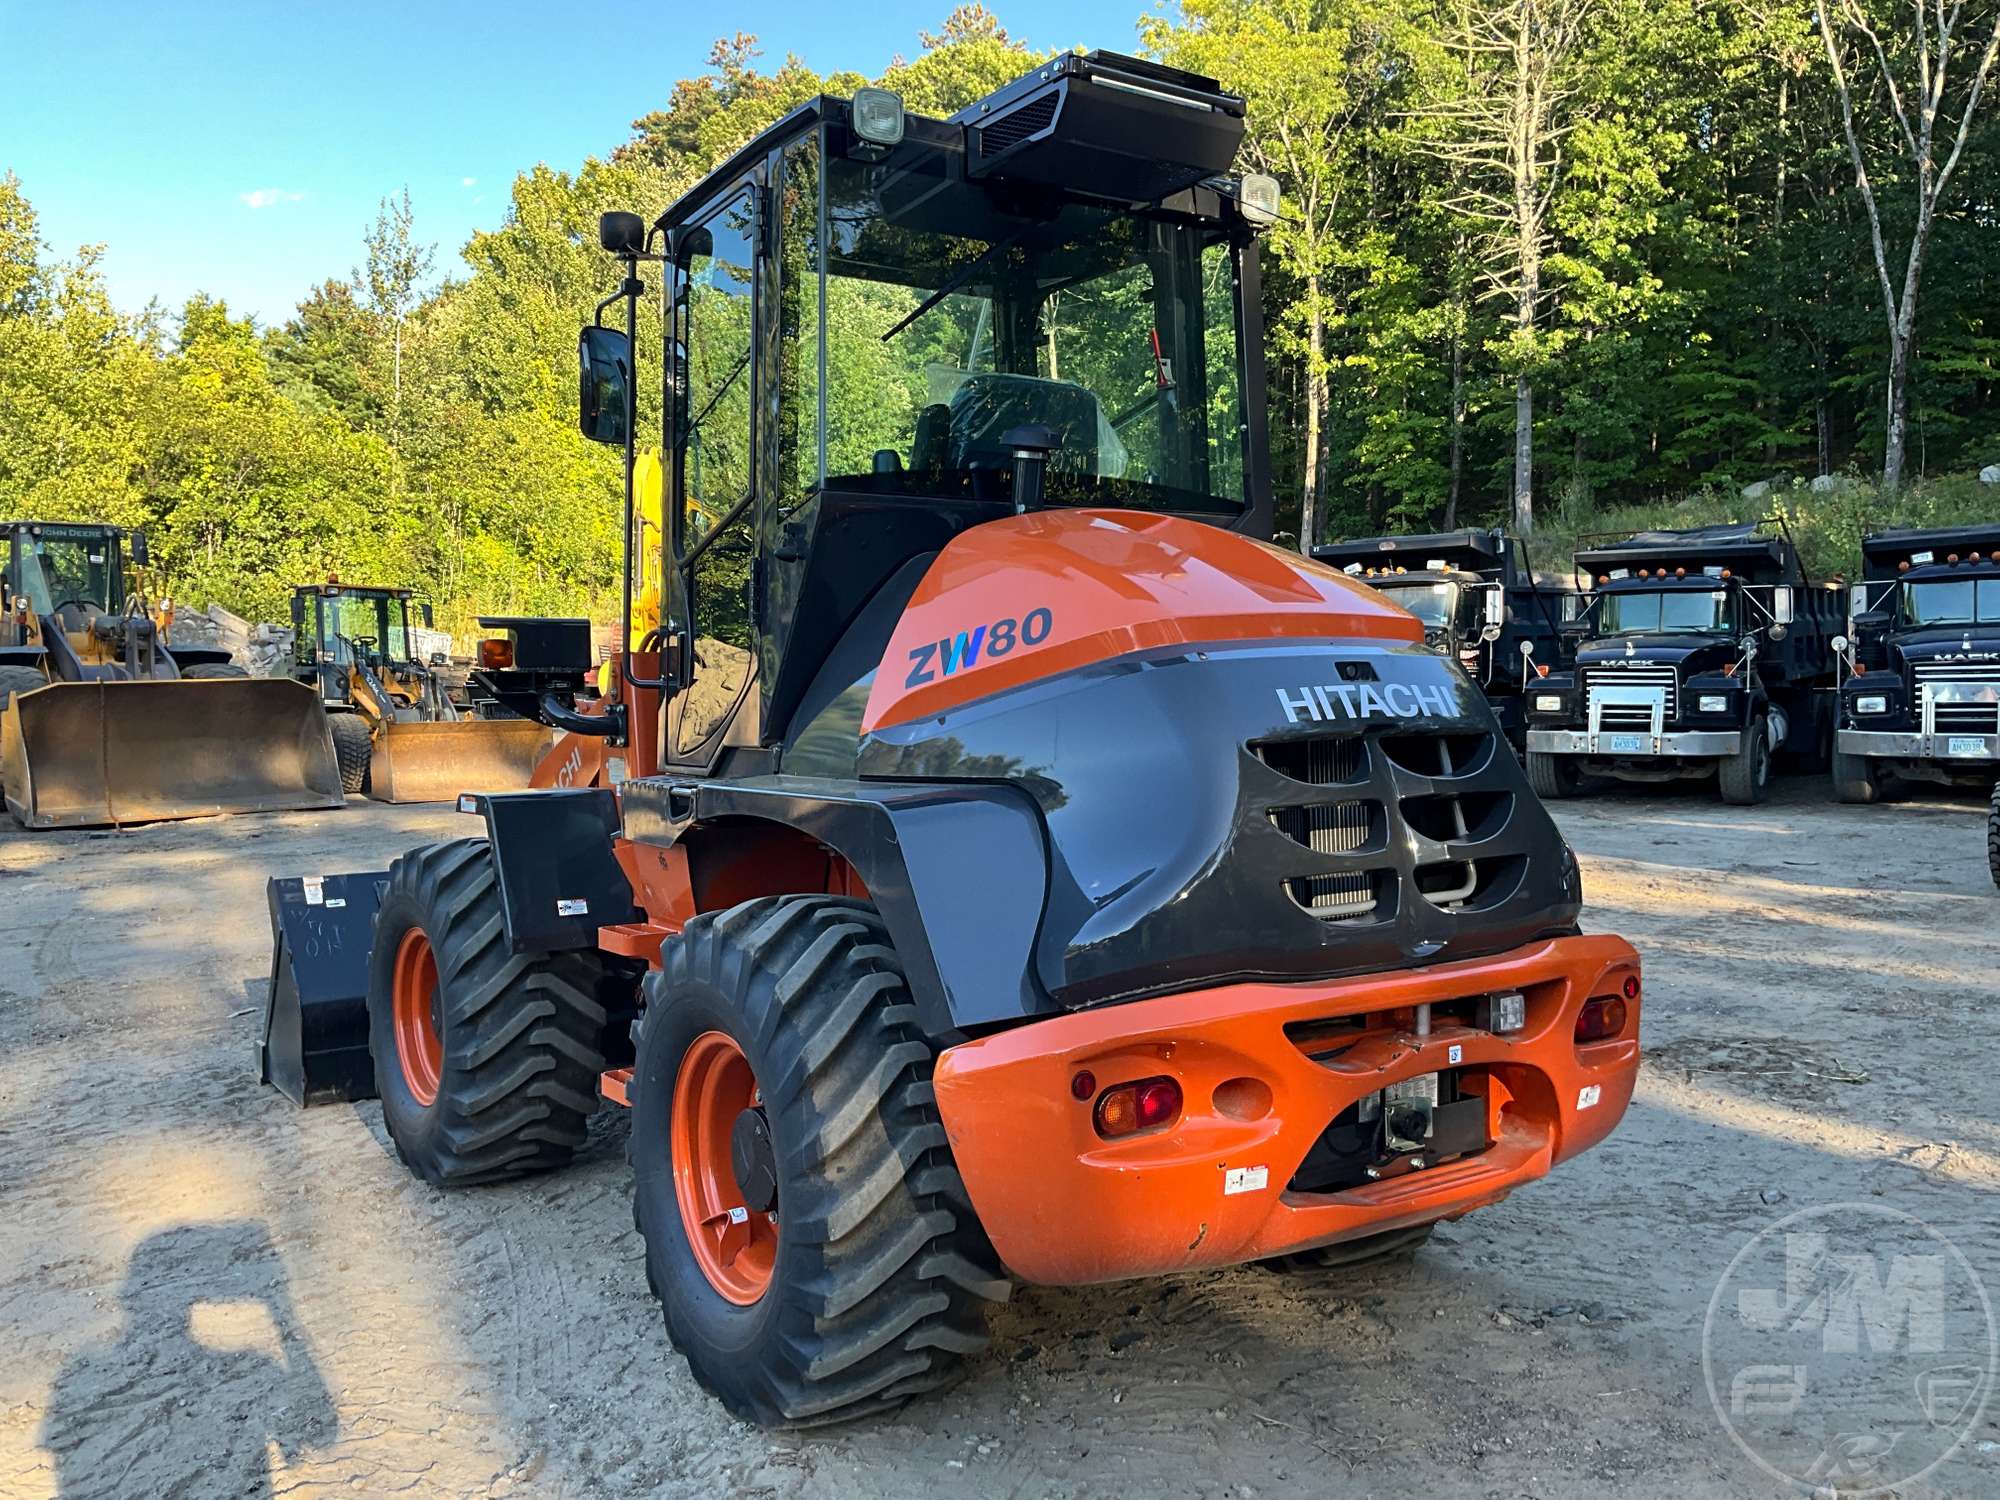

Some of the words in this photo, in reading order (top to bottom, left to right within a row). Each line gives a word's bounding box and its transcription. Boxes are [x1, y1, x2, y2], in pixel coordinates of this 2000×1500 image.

[68, 529, 102, 538] DEERE
[904, 607, 1053, 690] ZW80
[1934, 652, 2000, 662] MACK
[1275, 683, 1462, 723] HITACHI
